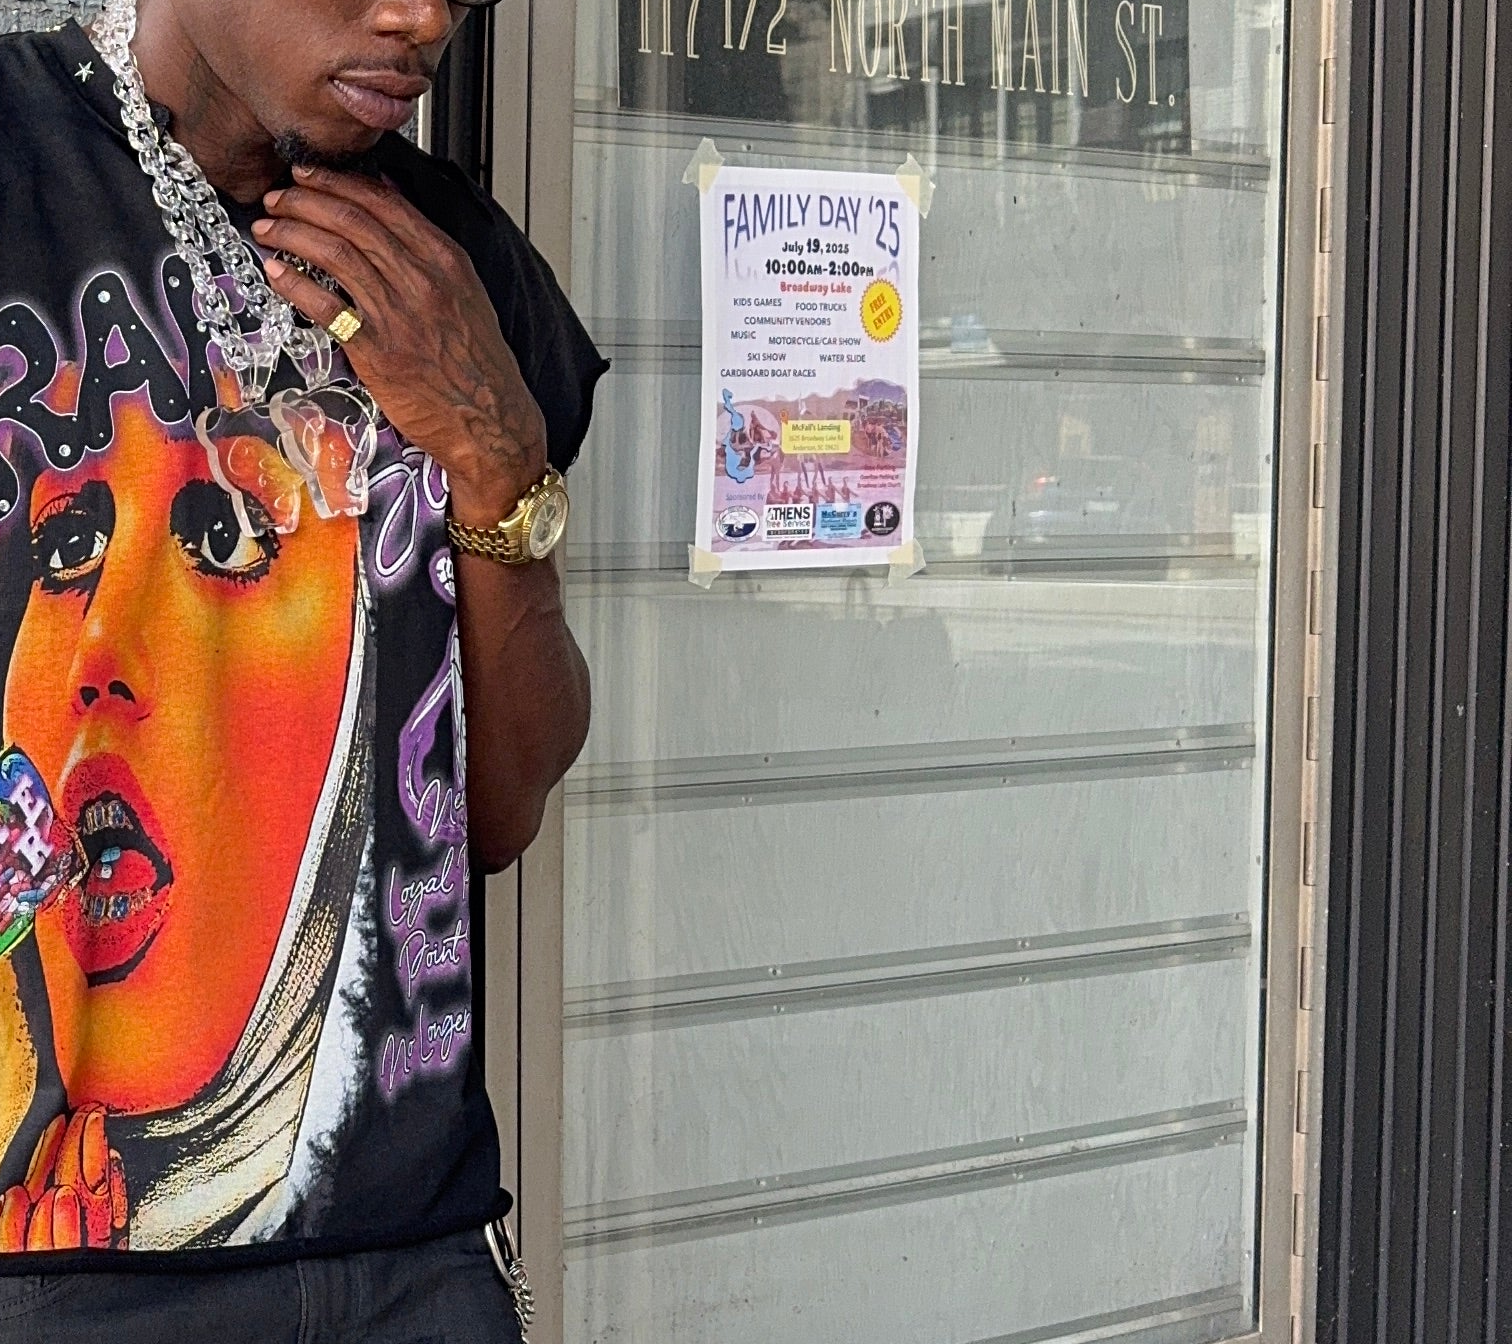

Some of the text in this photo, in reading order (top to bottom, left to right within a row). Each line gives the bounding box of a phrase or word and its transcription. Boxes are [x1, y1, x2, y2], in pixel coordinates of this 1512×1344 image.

[1115, 0, 1175, 106] ST.
[724, 193, 812, 257] FAMILY
[819, 194, 861, 235] DAY
[782, 238, 850, 255] July 19, 2025
[780, 281, 852, 296] Broadway Lake
[733, 298, 782, 307] KIDS GAMES
[795, 302, 847, 312] FOOD TRUCKS
[869, 292, 887, 314] FREE
[744, 316, 831, 326] COMMUNITY VENDORS
[873, 305, 894, 331] ENTRY
[731, 331, 756, 339] MUSIC
[838, 337, 861, 346] SHOW
[747, 353, 786, 361] SKI SHOW
[819, 354, 866, 363] WATER SLIDE
[720, 369, 816, 377] CARDBOARD BOAT RACES
[389, 846, 454, 928] Loyal
[381, 1003, 471, 1090] No Longer
